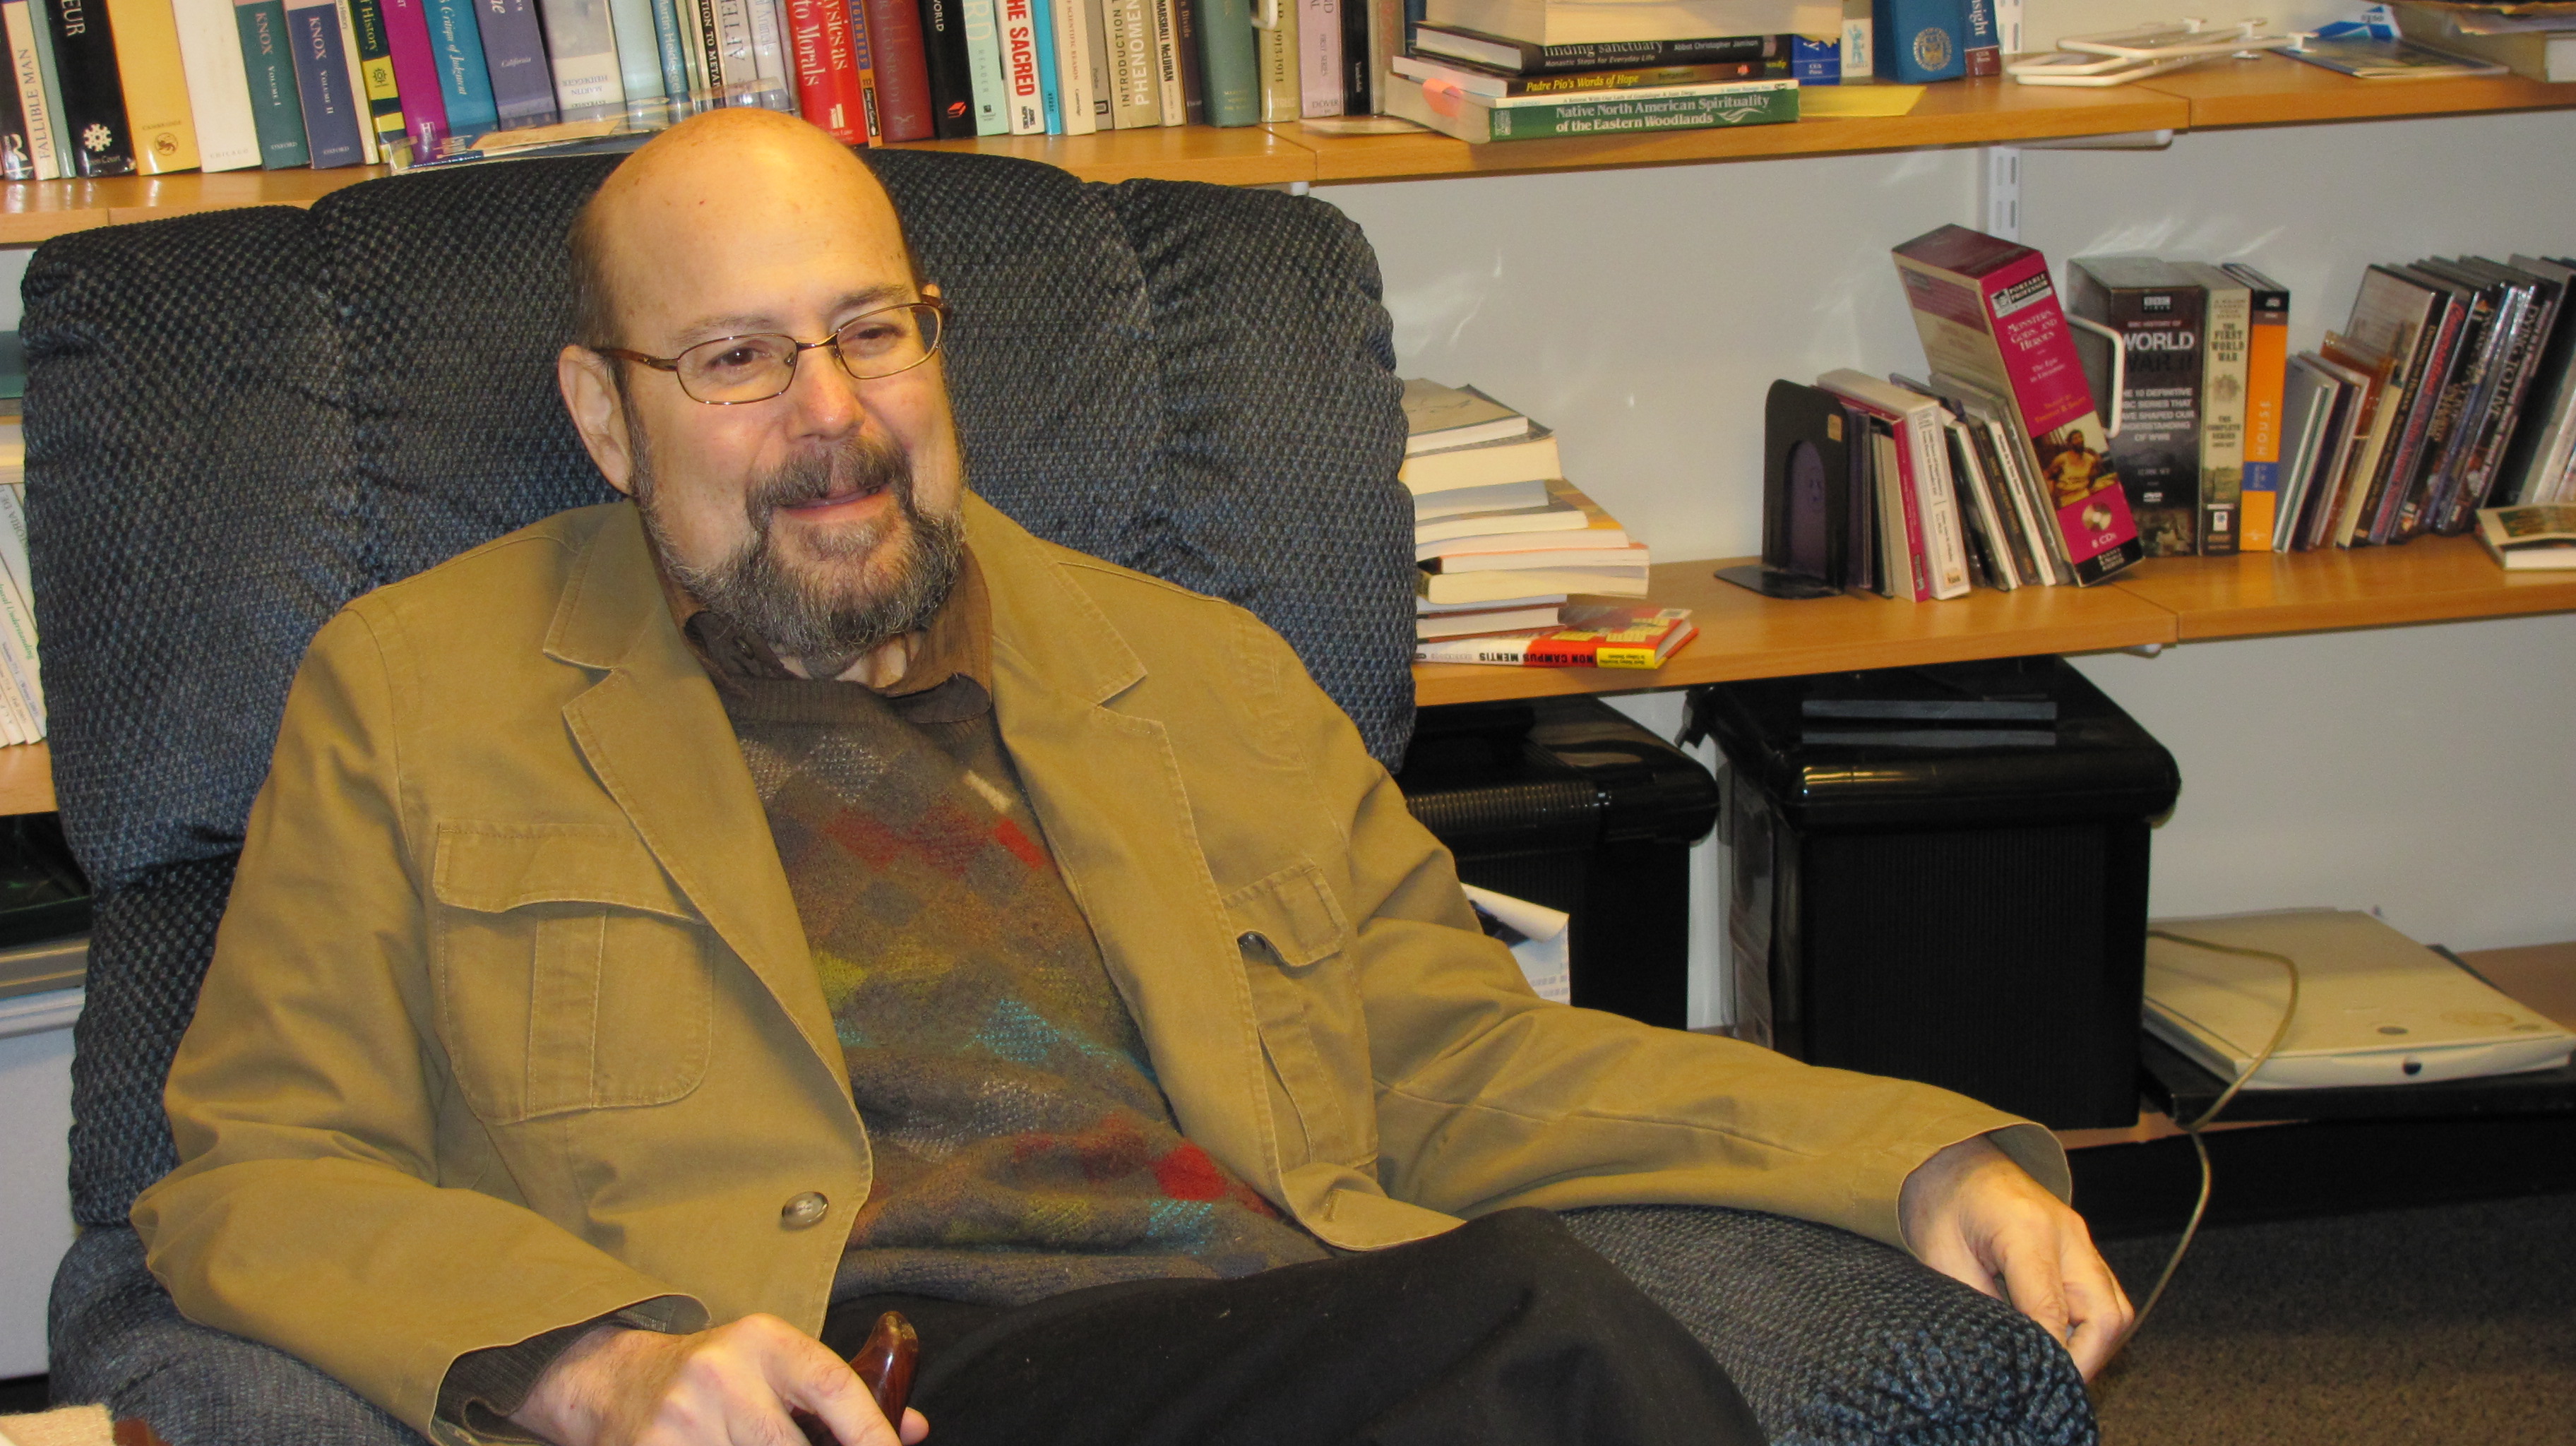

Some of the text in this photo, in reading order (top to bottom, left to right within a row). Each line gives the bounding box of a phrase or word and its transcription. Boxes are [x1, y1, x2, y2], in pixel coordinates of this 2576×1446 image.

[657, 0, 670, 30] artin
[256, 12, 274, 55] KNOX
[309, 16, 328, 60] KNOX
[361, 7, 378, 51] History
[707, 31, 715, 47] TO
[447, 44, 463, 54] of
[1066, 6, 1080, 80] SCIENTIFIC REASON
[1598, 40, 1664, 54] sanctuary
[796, 24, 826, 86] Morals
[830, 49, 848, 71] as
[1009, 26, 1036, 97] SACRED
[1113, 9, 1131, 107] INTRODUCTION
[1160, 43, 1174, 82] McLUHAN
[1609, 55, 1640, 64] Everyday
[978, 49, 990, 93] READER
[1525, 74, 1640, 92] Padre Pio's Words of Hope
[18, 49, 51, 160] FALLIBLE MAN
[1312, 98, 1339, 107] DOVER
[1556, 93, 1770, 119] Native North American Spirituality
[1556, 113, 1715, 132] of the Eastern Woodlands
[270, 141, 298, 150] OXFORD
[323, 146, 350, 155] OXFORD
[2214, 330, 2243, 340] FIRST
[2511, 304, 2541, 357] DYING
[2123, 331, 2195, 352] WORLD
[2210, 340, 2245, 351] WORLD
[2217, 352, 2238, 362] WAR
[2256, 400, 2272, 457] HOUSE
[5, 601, 33, 660] Understanding
[1479, 652, 1519, 662] MENTIS
[1522, 654, 1568, 663] CAMPUS
[1571, 655, 1594, 664] NON
